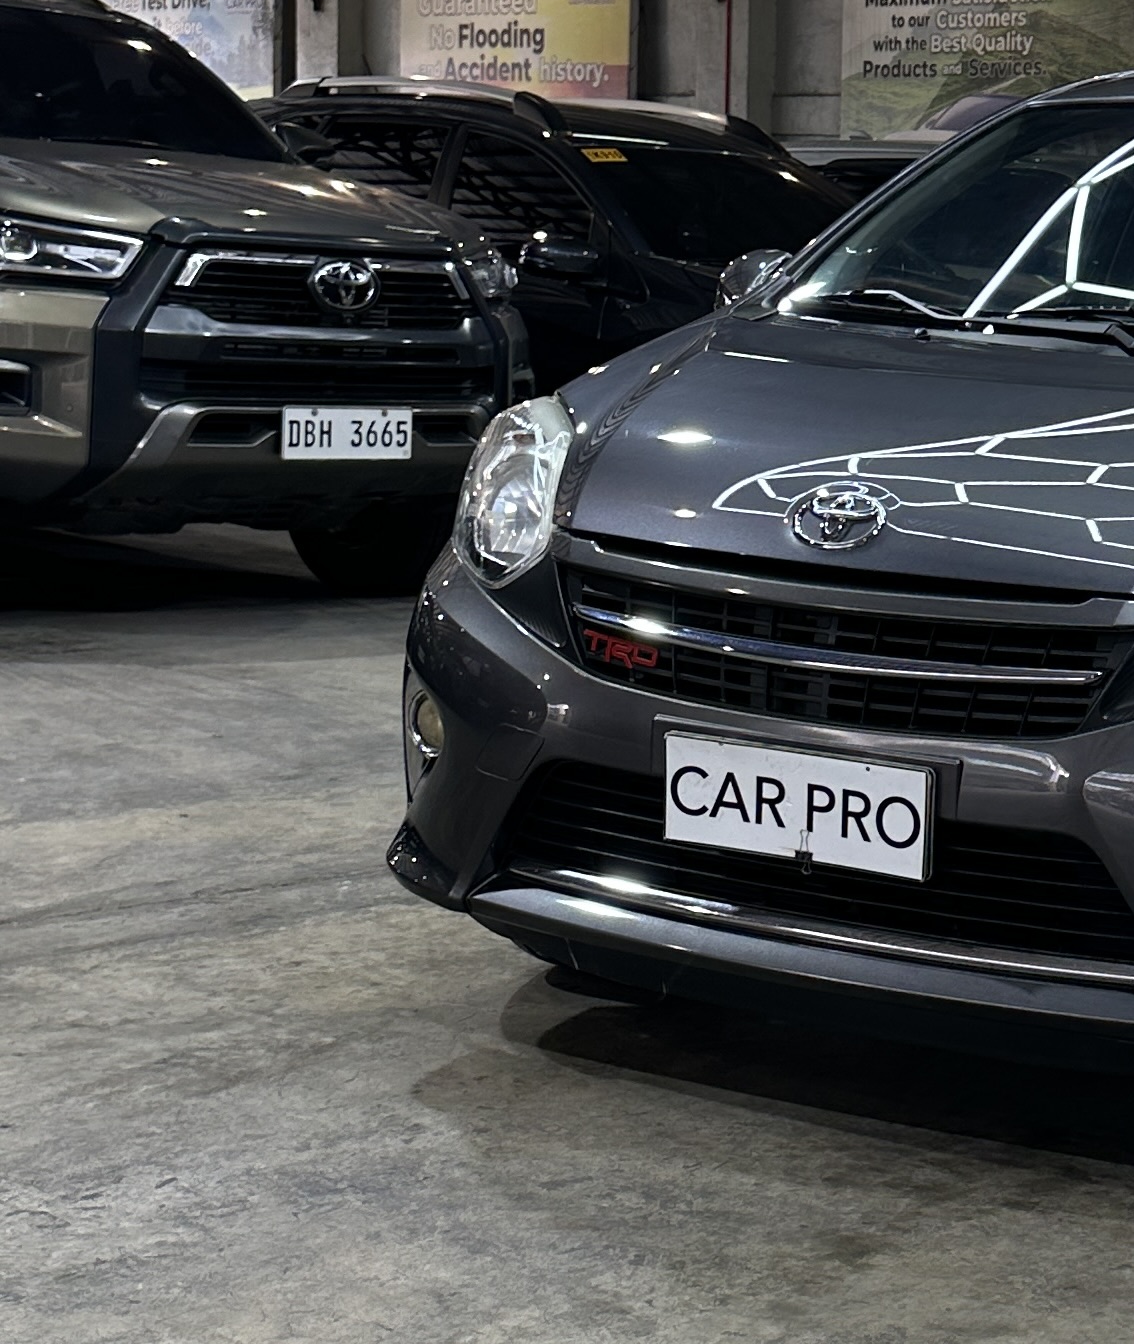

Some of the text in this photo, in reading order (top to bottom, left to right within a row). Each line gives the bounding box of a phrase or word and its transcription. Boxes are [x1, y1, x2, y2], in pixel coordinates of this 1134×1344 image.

[892, 10, 1026, 28] to our Customers
[429, 20, 545, 53] No Flooding
[873, 31, 1033, 55] with the Best Quality
[418, 54, 609, 86] and Accident history.
[863, 58, 1047, 78] Products and Services.
[288, 420, 408, 448] DBH 3665
[583, 629, 658, 669] TRD
[670, 765, 921, 849] CAR PRO
